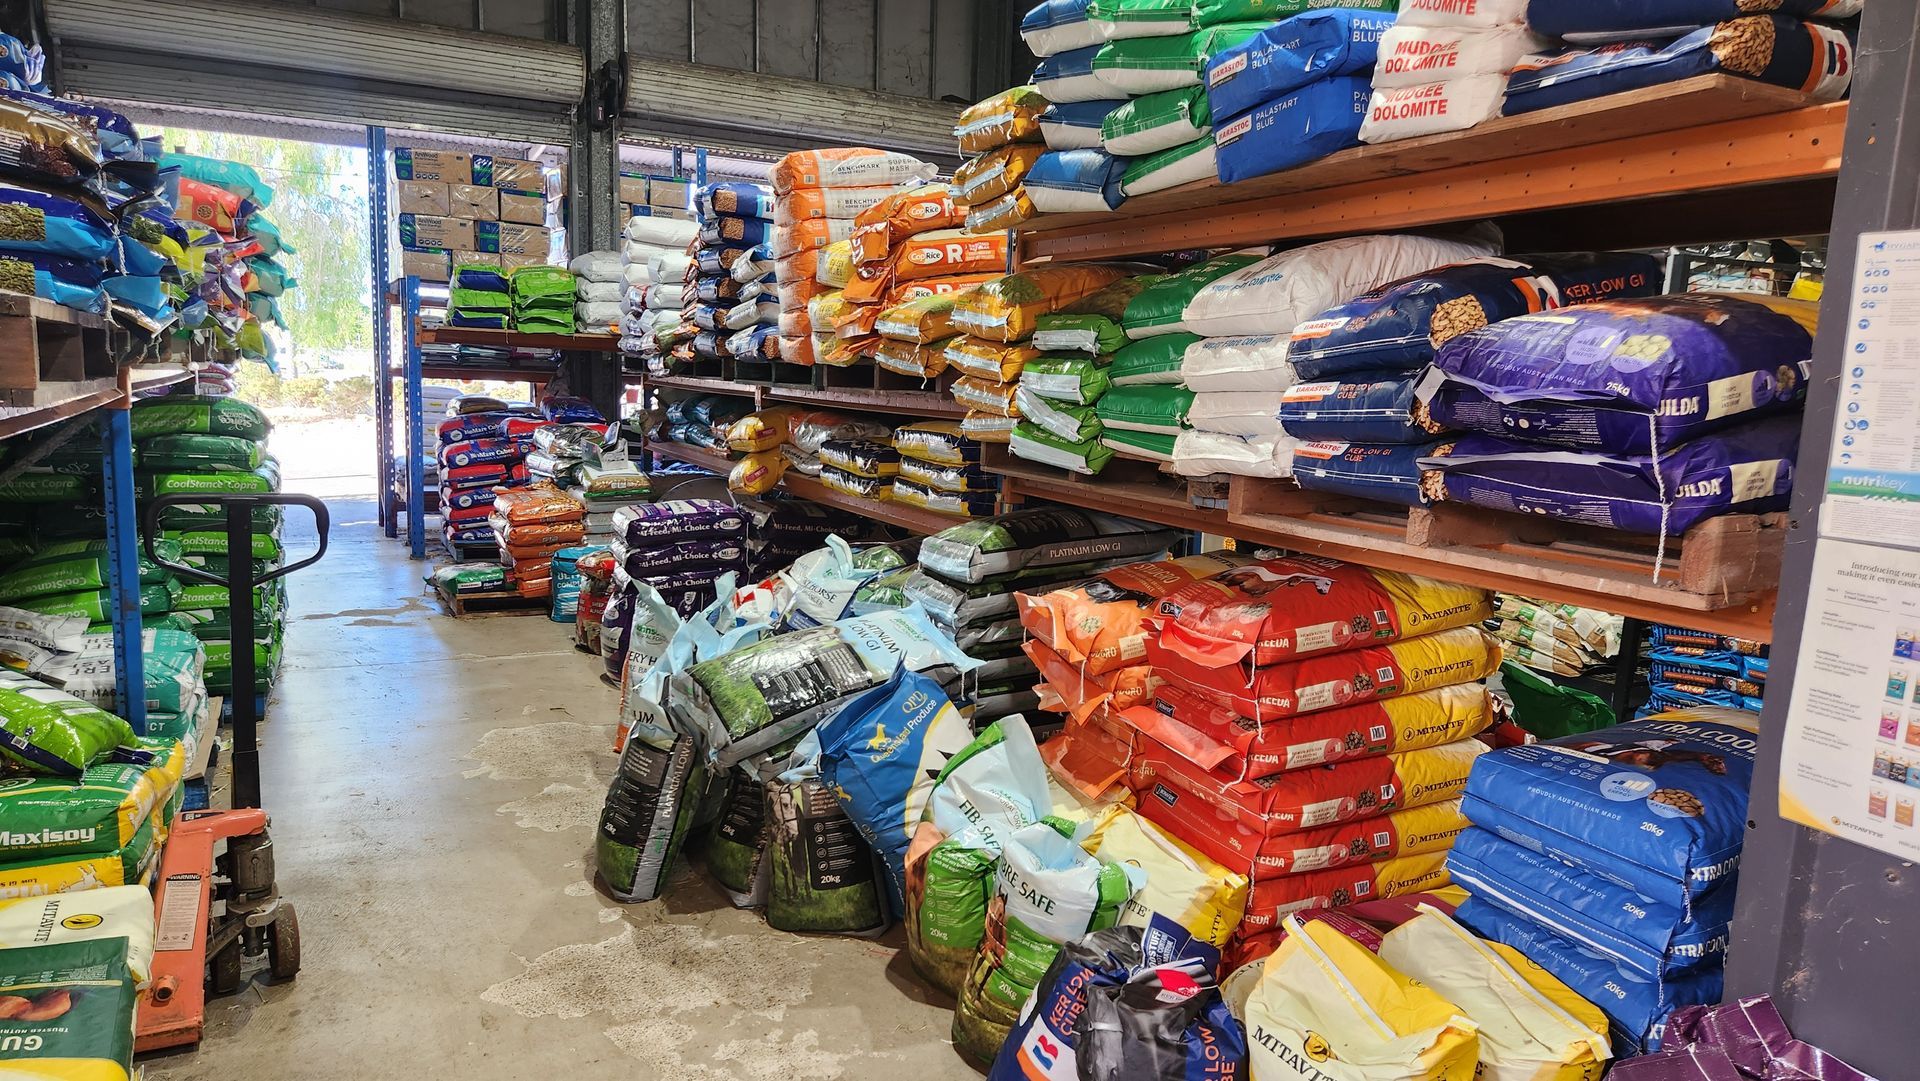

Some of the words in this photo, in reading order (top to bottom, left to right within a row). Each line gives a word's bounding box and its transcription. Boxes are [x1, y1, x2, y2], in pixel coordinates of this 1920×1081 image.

[1255, 97, 1298, 121] PALASTART
[1373, 99, 1448, 122] DOLOMITE
[1218, 119, 1250, 142] BARASTOC
[1256, 116, 1274, 132] BLUE
[838, 164, 881, 172] BENCHMARK
[910, 203, 941, 218] CopRice
[909, 249, 943, 264] CopRice
[946, 243, 963, 264] R
[1564, 284, 1591, 299] KER
[1595, 277, 1625, 294] LOW
[1630, 274, 1645, 288] GI
[1296, 385, 1333, 393] BARASTOC
[1337, 391, 1357, 399] CUBE
[1604, 381, 1632, 397] 25kg
[1344, 454, 1365, 462] CUBE
[166, 479, 224, 489] CoolStance
[227, 480, 257, 491] Copra
[1841, 474, 1908, 493] nutrikey
[672, 523, 711, 534] MI-Choice
[672, 552, 710, 564] MI-Choice
[1050, 546, 1090, 558] PLATINUM
[1092, 545, 1111, 553] LOW
[1111, 543, 1121, 551] GI
[1837, 569, 1868, 582] making
[1869, 574, 1876, 582] it
[1877, 576, 1897, 586] even
[1850, 561, 1901, 577] Introducing
[1901, 572, 1918, 580] our
[1422, 603, 1471, 621] MITAVITE
[866, 639, 881, 651] GI
[1423, 659, 1474, 677] MITAVITE
[870, 725, 910, 763] Queensland
[908, 699, 937, 730] Produce
[1416, 719, 1464, 737] MITAVITE
[662, 773, 681, 818] PLATINUM
[679, 749, 691, 770] LOW
[1607, 788, 1632, 799] ENERGY
[1527, 786, 1556, 800] PROUDLY
[1556, 794, 1600, 814] AUSTRALIAN
[1601, 809, 1622, 821] MADE
[1640, 820, 1665, 837] 20kg
[1228, 836, 1243, 851] 20kg
[169, 873, 201, 881] WARNING
[819, 874, 841, 885] 20kg
[1516, 851, 1545, 869] PROUDLY
[1543, 865, 1587, 892] AUSTRALIAN
[1586, 886, 1607, 900] MADE
[1690, 864, 1722, 882] XTRA
[1018, 881, 1057, 916] SAFE
[1622, 902, 1646, 919] 20kg
[33, 899, 61, 944] MITAVITE
[1506, 922, 1535, 941] PROUDLY
[1569, 961, 1590, 978] MADE
[998, 979, 1018, 1001] 20kg
[1604, 980, 1627, 999] 20kg
[1049, 997, 1071, 1028] KER
[30, 1026, 70, 1034] TRUSTED
[1203, 1026, 1221, 1073] LOW
